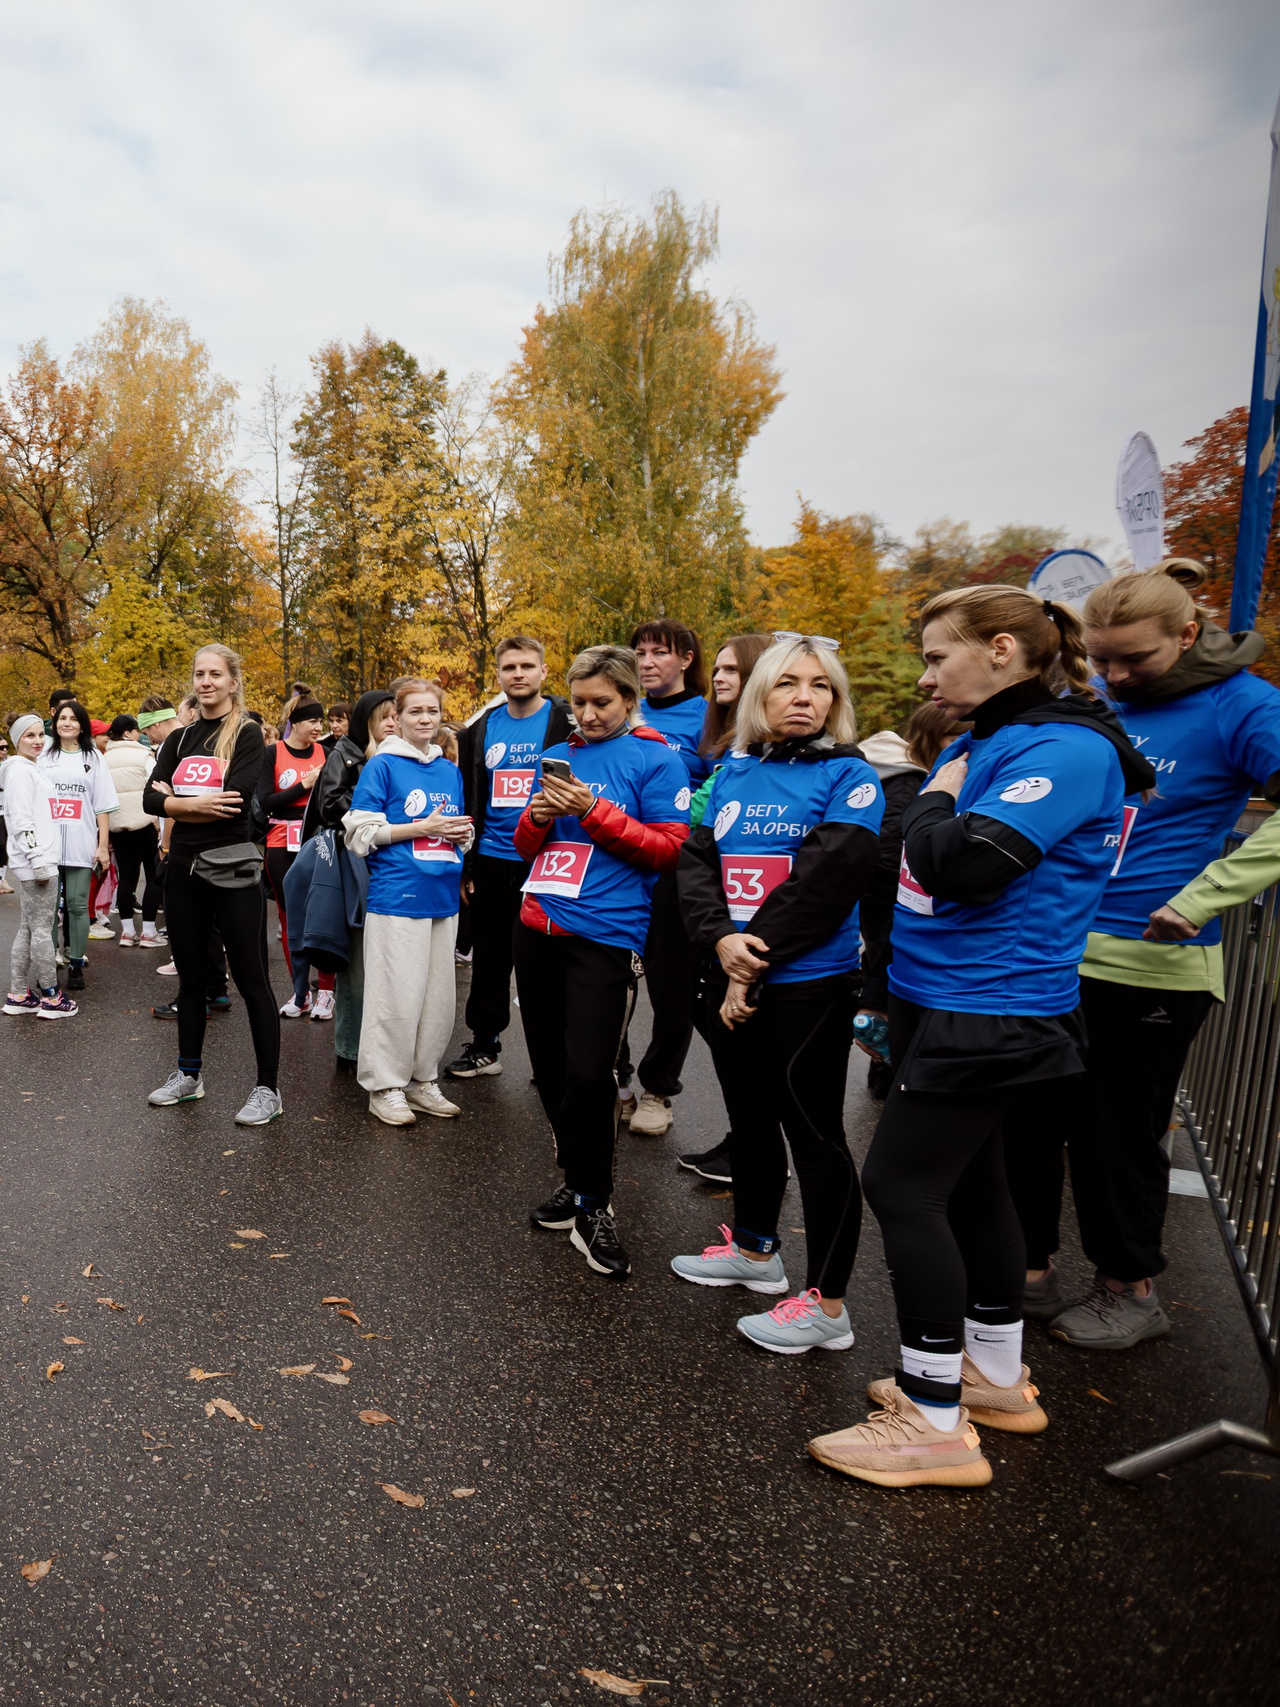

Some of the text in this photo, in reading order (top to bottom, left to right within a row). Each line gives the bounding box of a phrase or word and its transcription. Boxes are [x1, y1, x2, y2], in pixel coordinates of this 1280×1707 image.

[510, 742, 537, 753] БЕГУ
[509, 754, 541, 764] ЗА ОР
[1145, 756, 1177, 774] БИ
[183, 763, 212, 783] 59
[55, 783, 86, 793] ЛОНТЕ
[429, 792, 452, 801] БЕГУ
[58, 803, 75, 817] 75
[745, 804, 788, 817] БЕГУ
[740, 822, 760, 835] ЗА
[540, 850, 577, 878] 132
[726, 867, 765, 901] 53
